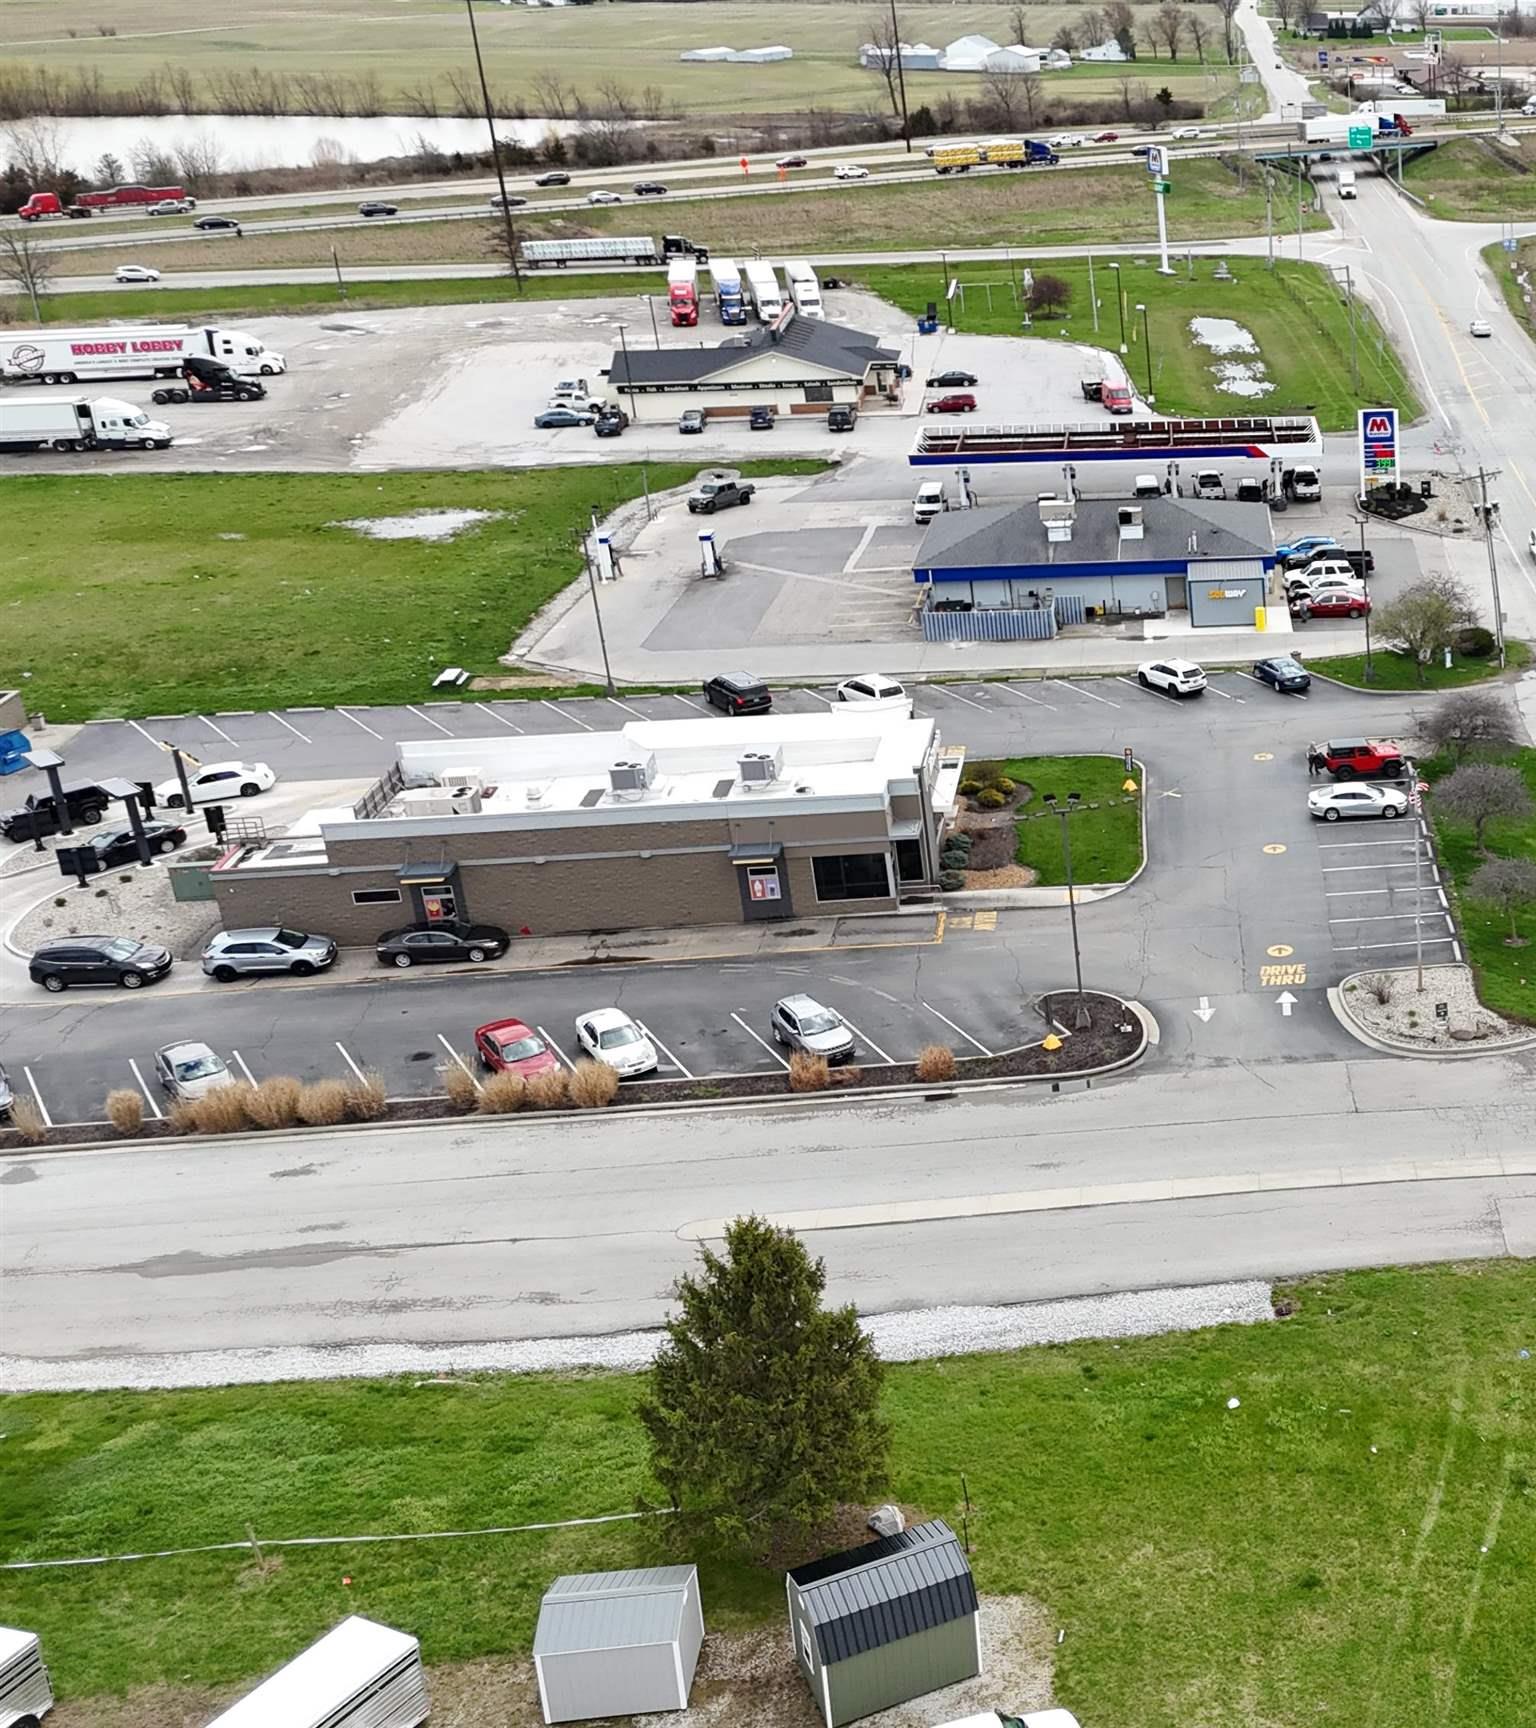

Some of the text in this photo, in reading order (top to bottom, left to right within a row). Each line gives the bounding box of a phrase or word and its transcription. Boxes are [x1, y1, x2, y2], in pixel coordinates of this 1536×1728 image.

[70, 339, 184, 356] HOBBY LOBBY
[1208, 589, 1247, 599] SUBWAY
[1260, 963, 1307, 977] DRIVE
[1261, 974, 1307, 987] THRU
